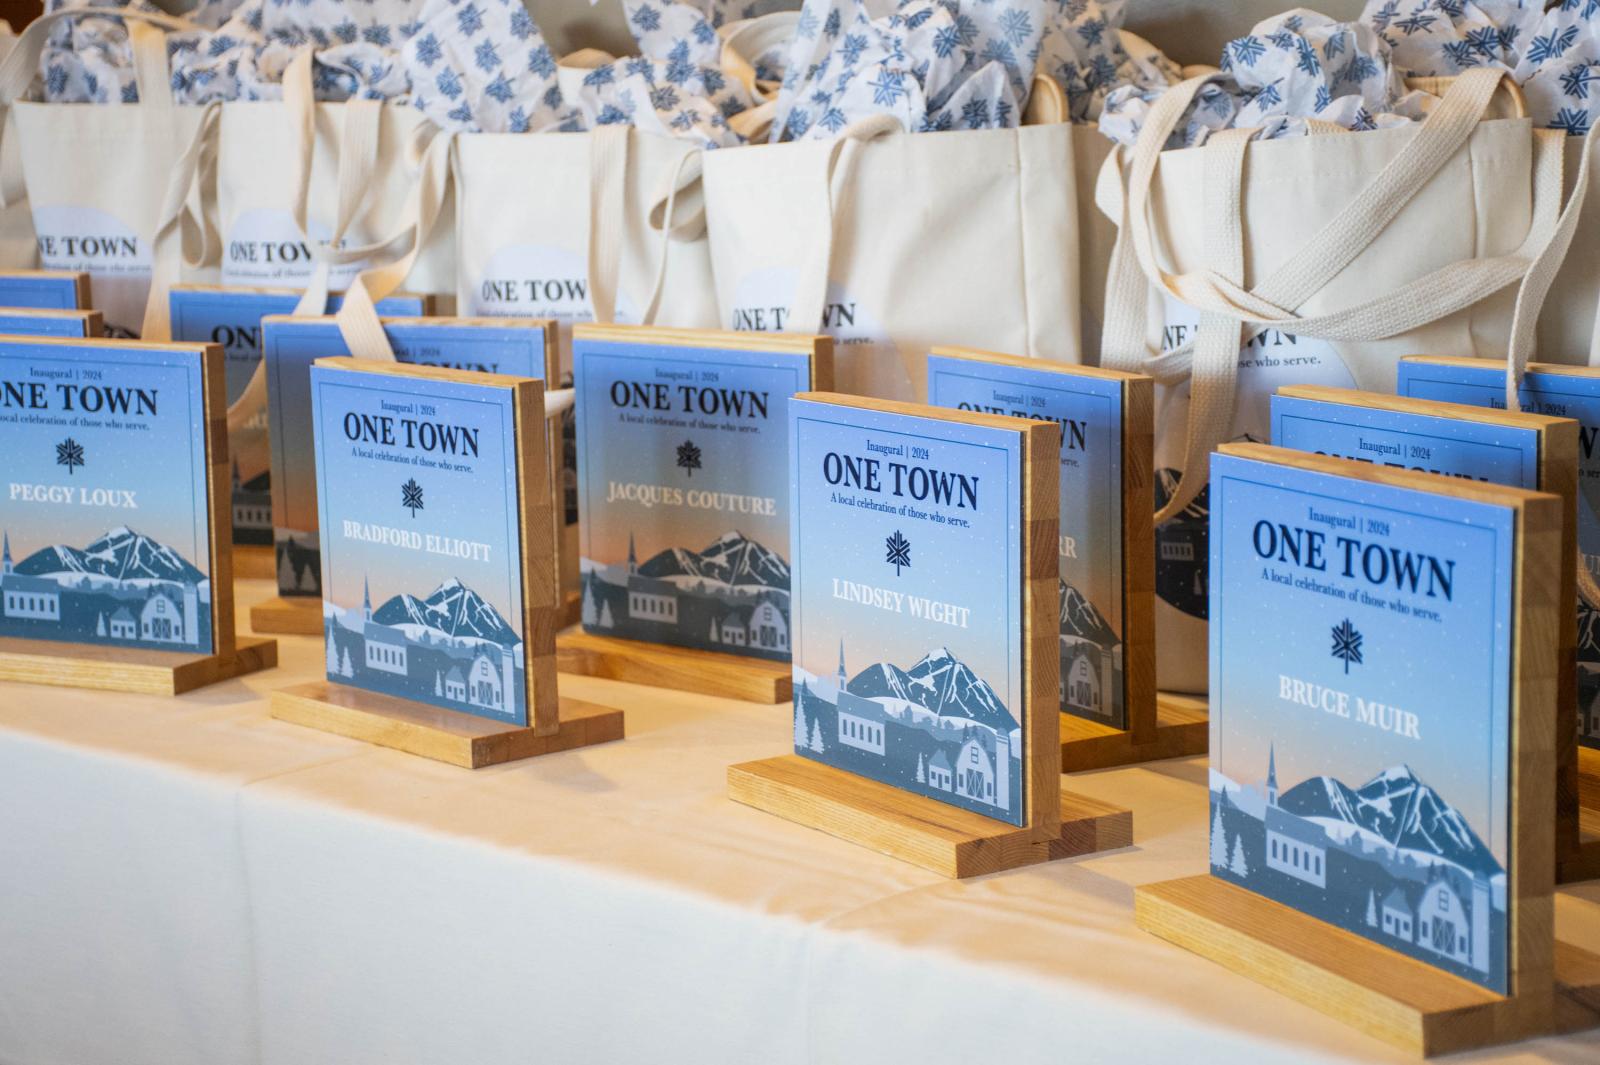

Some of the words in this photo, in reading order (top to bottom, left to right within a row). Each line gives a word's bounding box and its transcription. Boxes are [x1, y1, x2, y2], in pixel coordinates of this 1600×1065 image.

[61, 235, 137, 257] TOWN
[230, 240, 257, 262] ONE
[482, 279, 518, 301] ONE
[524, 278, 587, 301] TOW
[30, 367, 72, 380] Inaugural
[82, 370, 102, 381] 2024
[1255, 355, 1280, 367] who
[1283, 356, 1321, 366] serve.
[655, 368, 693, 382] Inaugural
[0, 381, 48, 409] NE
[56, 384, 158, 416] TOWN
[381, 399, 413, 415] Inaugural
[420, 403, 436, 416] 2024
[610, 380, 671, 411] ONE
[678, 386, 769, 419] TOWN
[21, 413, 67, 426] celebration
[69, 416, 78, 427] of
[80, 417, 102, 428] those
[105, 419, 122, 429] who
[125, 423, 150, 431] serve.
[343, 412, 396, 446] ONE
[401, 419, 479, 458] TOWN
[619, 413, 625, 422] A
[627, 414, 644, 424] local
[646, 415, 687, 427] celebration
[689, 417, 698, 428] of
[699, 419, 718, 430] those
[720, 421, 736, 432] who
[738, 425, 760, 434] serve.
[351, 447, 357, 457] A
[358, 448, 374, 460] local
[375, 452, 410, 465] celebration
[411, 455, 419, 466] of
[419, 457, 437, 468] those
[438, 459, 453, 471] who
[454, 464, 474, 474] serve.
[866, 439, 904, 457] Inaugural
[912, 447, 930, 460] 2024
[1359, 438, 1401, 456] Inaugural
[1411, 446, 1431, 460] 2024
[823, 452, 881, 493] ONE
[889, 462, 979, 511] TOWN
[9, 483, 75, 504] PEGGY
[80, 488, 138, 509] LOUX
[607, 481, 684, 508] JACQUES
[687, 490, 777, 516] COUTURE
[830, 492, 837, 502] A
[838, 493, 855, 506] local
[856, 496, 897, 514] celebration
[898, 505, 908, 516] of
[908, 507, 928, 521] those
[929, 511, 945, 524] who
[947, 517, 970, 529] serve.
[1308, 507, 1356, 532] Inaugural
[1367, 519, 1390, 537] 2024
[342, 519, 422, 550] BRADFORD
[426, 534, 492, 562] ELLIOTT
[1253, 519, 1326, 571] ONE
[1336, 536, 1456, 602] TOWN
[832, 578, 904, 613] LINDSEY
[908, 595, 970, 629] WIGHT
[1261, 567, 1270, 580] A
[1271, 569, 1292, 586] local
[1295, 573, 1346, 600] celebration
[1348, 588, 1359, 602] of
[1361, 592, 1387, 609] those
[1389, 598, 1410, 615] who
[1413, 607, 1442, 623] serve.
[1279, 674, 1350, 718] BRUCE
[1355, 697, 1422, 740] MUIR
